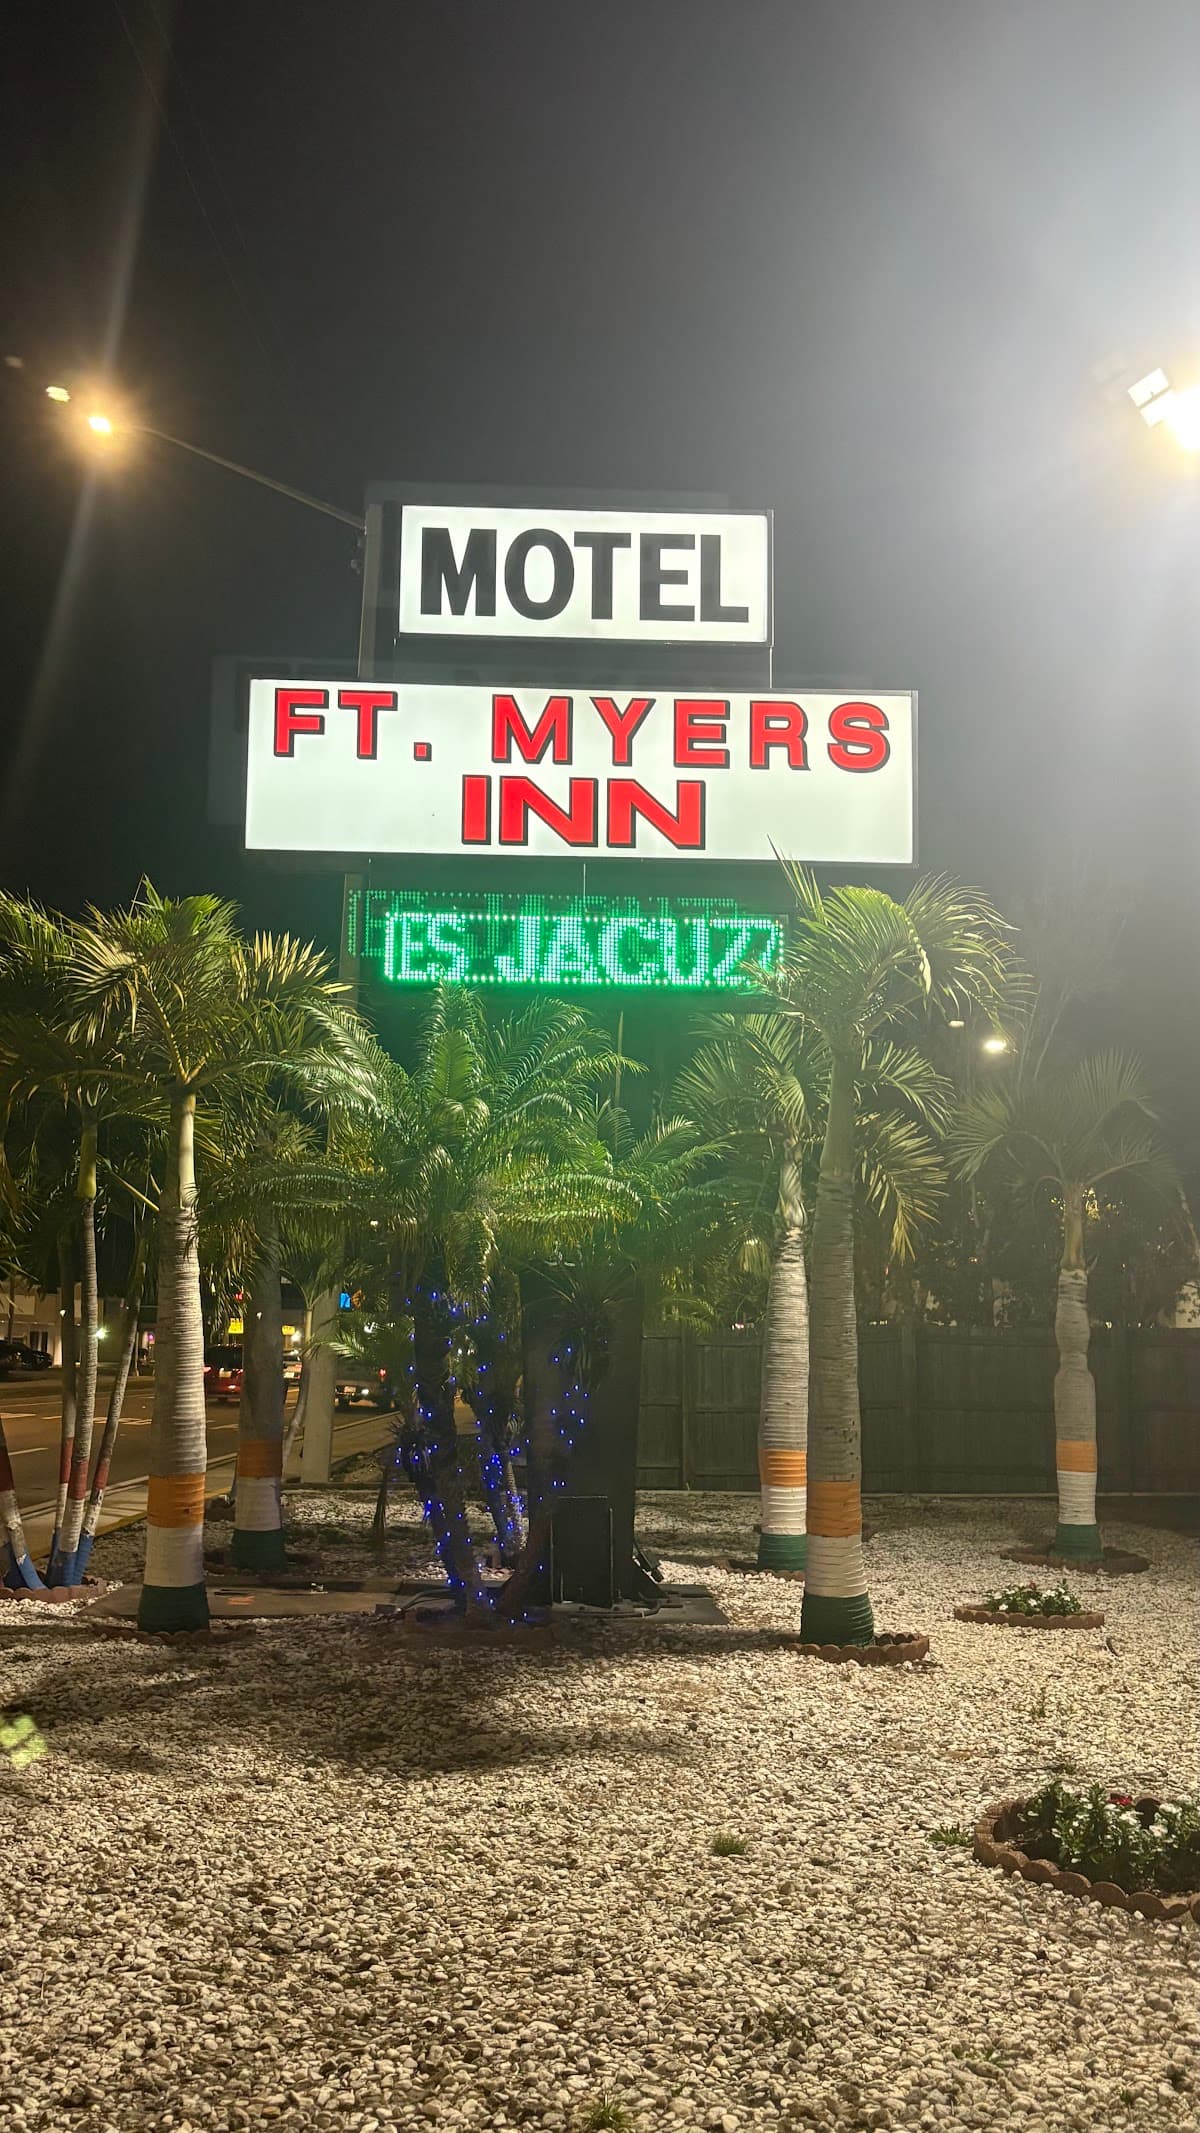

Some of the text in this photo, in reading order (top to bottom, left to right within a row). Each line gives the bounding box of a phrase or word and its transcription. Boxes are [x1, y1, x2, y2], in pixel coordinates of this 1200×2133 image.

[420, 527, 749, 623] MOTEL
[273, 688, 891, 773] FT. MYERS
[462, 775, 706, 850] INN
